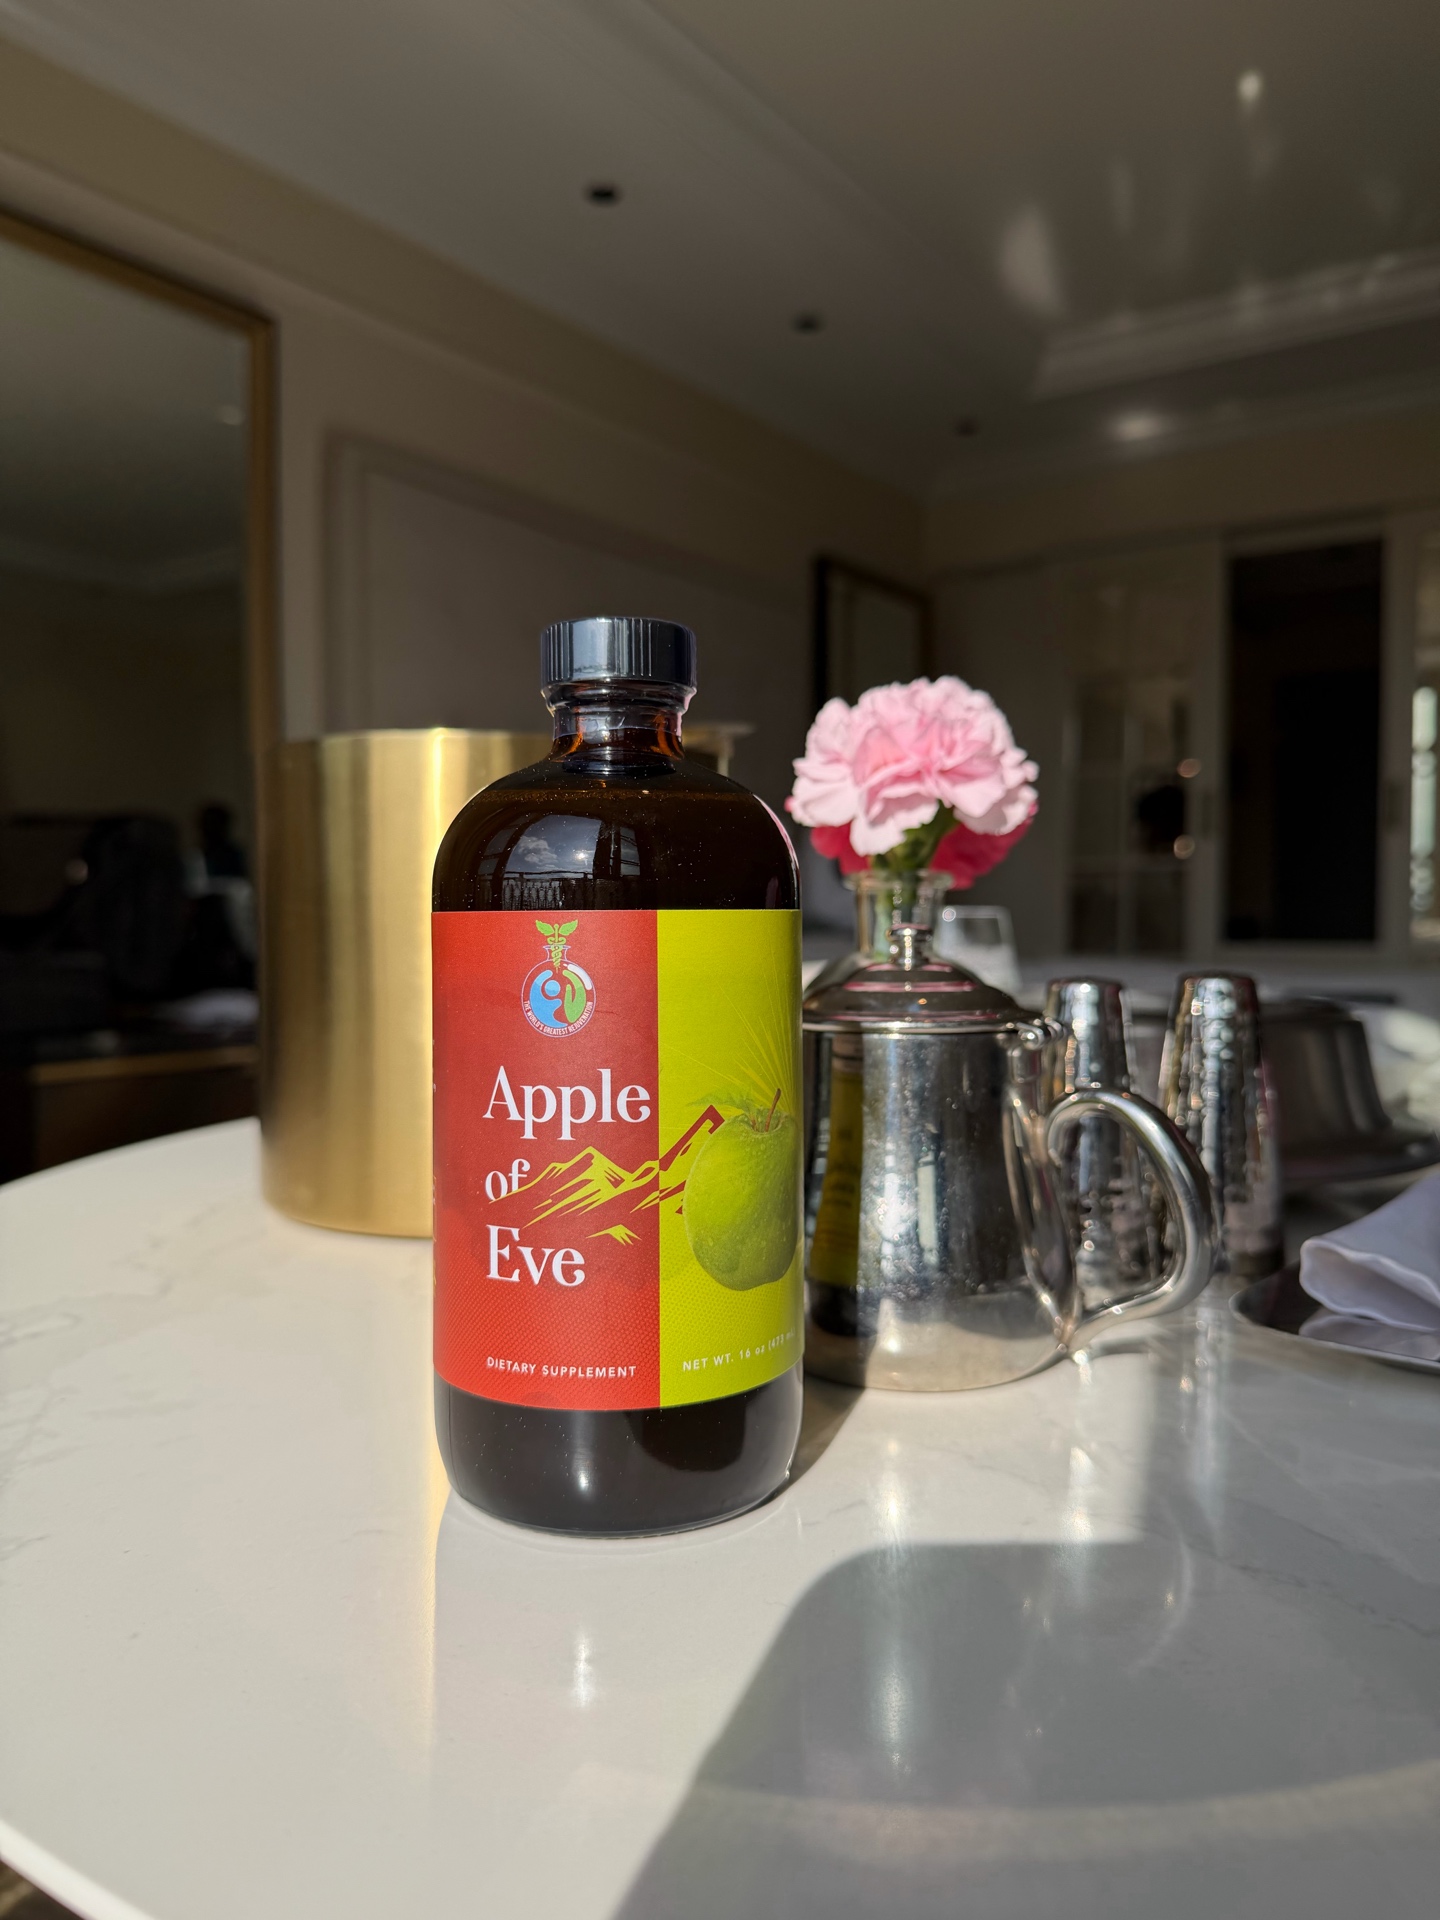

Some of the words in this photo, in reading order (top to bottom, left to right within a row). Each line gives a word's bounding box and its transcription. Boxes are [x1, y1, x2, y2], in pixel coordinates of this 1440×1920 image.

[523, 1000, 531, 1012] THE
[526, 1010, 545, 1031] WORLD'S
[568, 1001, 594, 1033] REJUVENATION
[543, 1026, 569, 1036] GREATEST
[482, 1065, 651, 1141] Apple
[485, 1158, 531, 1202] of
[486, 1224, 586, 1287] Eve
[486, 1356, 536, 1375] DIETARY
[542, 1365, 637, 1378] SUPPLEMENT
[682, 1357, 709, 1372] NET
[713, 1352, 734, 1366] WT.
[739, 1348, 751, 1359] 16
[755, 1344, 765, 1355] oz
[768, 1333, 785, 1351] (473
